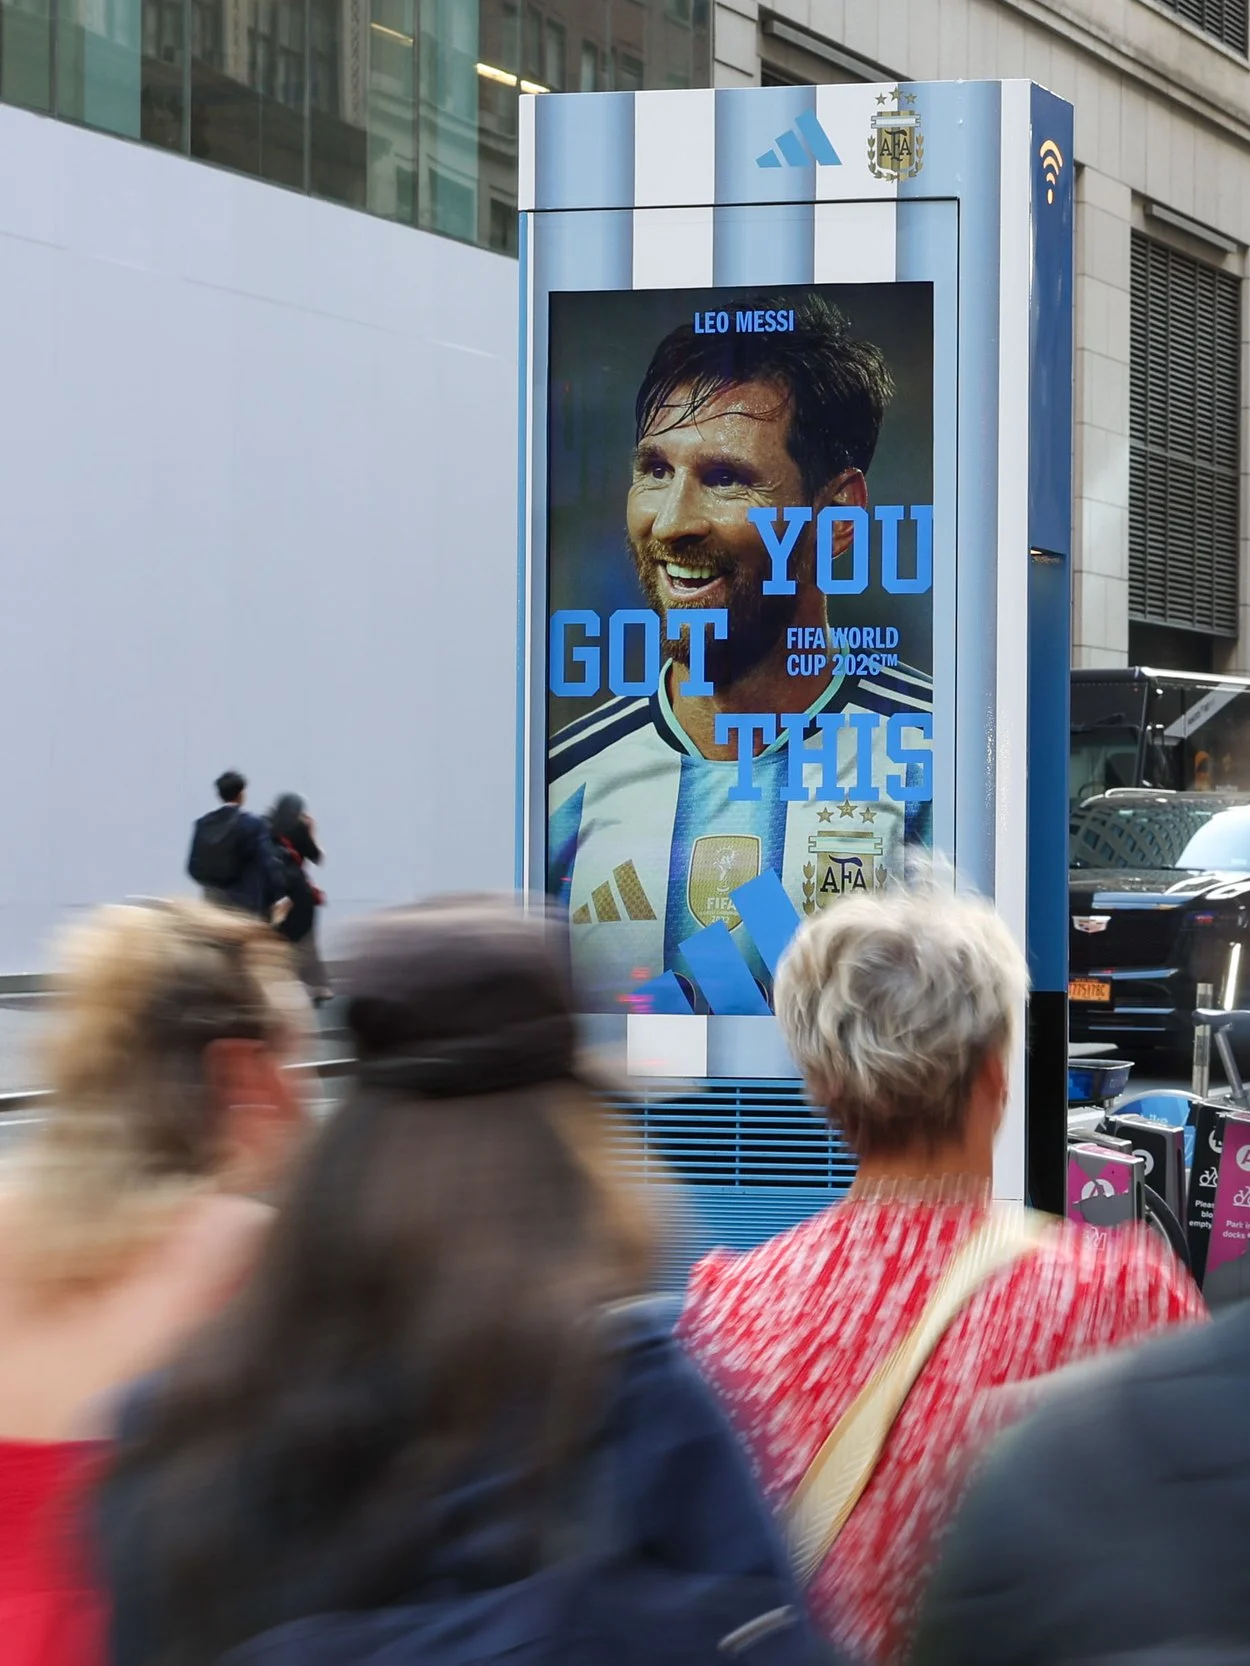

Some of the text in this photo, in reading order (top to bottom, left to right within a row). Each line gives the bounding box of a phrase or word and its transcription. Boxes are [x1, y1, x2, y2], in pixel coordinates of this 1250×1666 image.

[880, 129, 912, 162] AFA
[694, 310, 794, 334] LEO MESSI
[747, 504, 933, 596] YOU
[786, 626, 899, 649] FIFA WORLD
[549, 608, 729, 698] GOT
[786, 653, 827, 677] CUP
[714, 713, 933, 801] THIS
[1195, 1200, 1215, 1208] Pleas
[1222, 1230, 1245, 1239] docks
[1226, 1220, 1243, 1228] Park
